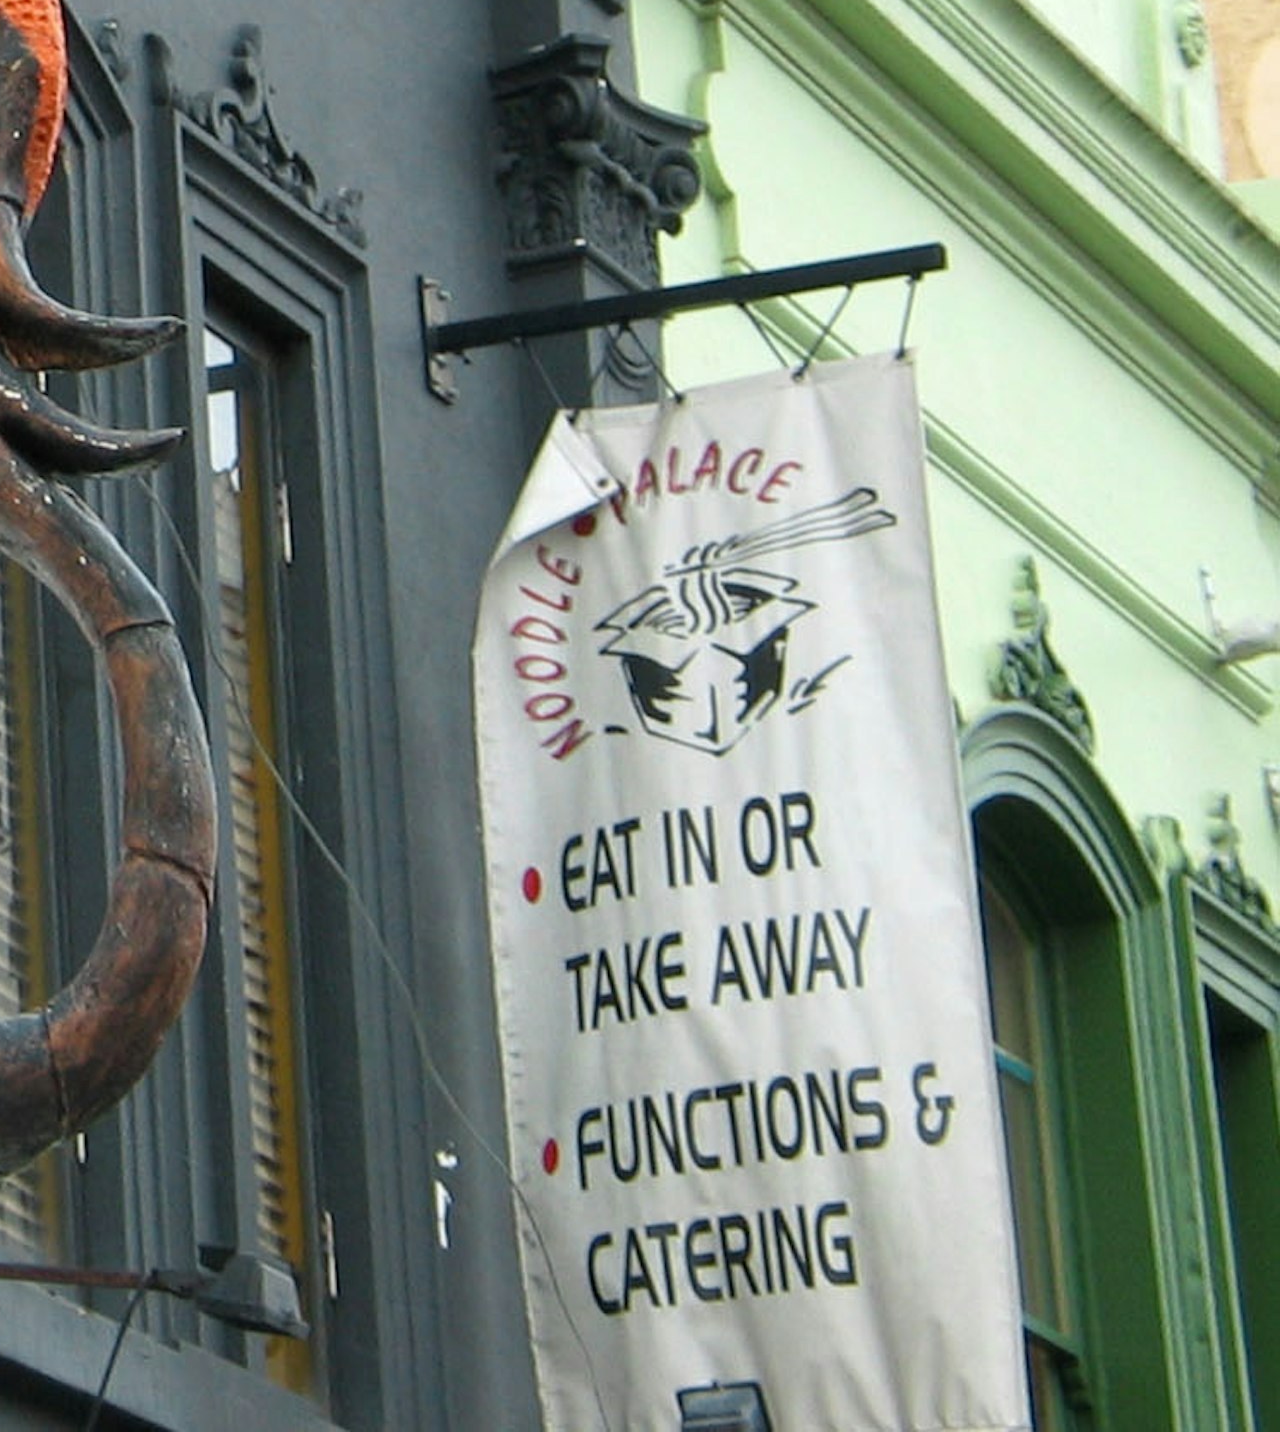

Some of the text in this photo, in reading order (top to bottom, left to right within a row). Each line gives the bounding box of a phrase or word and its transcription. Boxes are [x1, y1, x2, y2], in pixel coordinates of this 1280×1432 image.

[510, 544, 592, 760] NOODLE
[560, 791, 820, 912] EAT IN OR
[564, 907, 870, 1032] TAKE AWAY
[575, 1062, 954, 1190] FUNCTIONS &
[587, 1201, 858, 1316] CATERING
